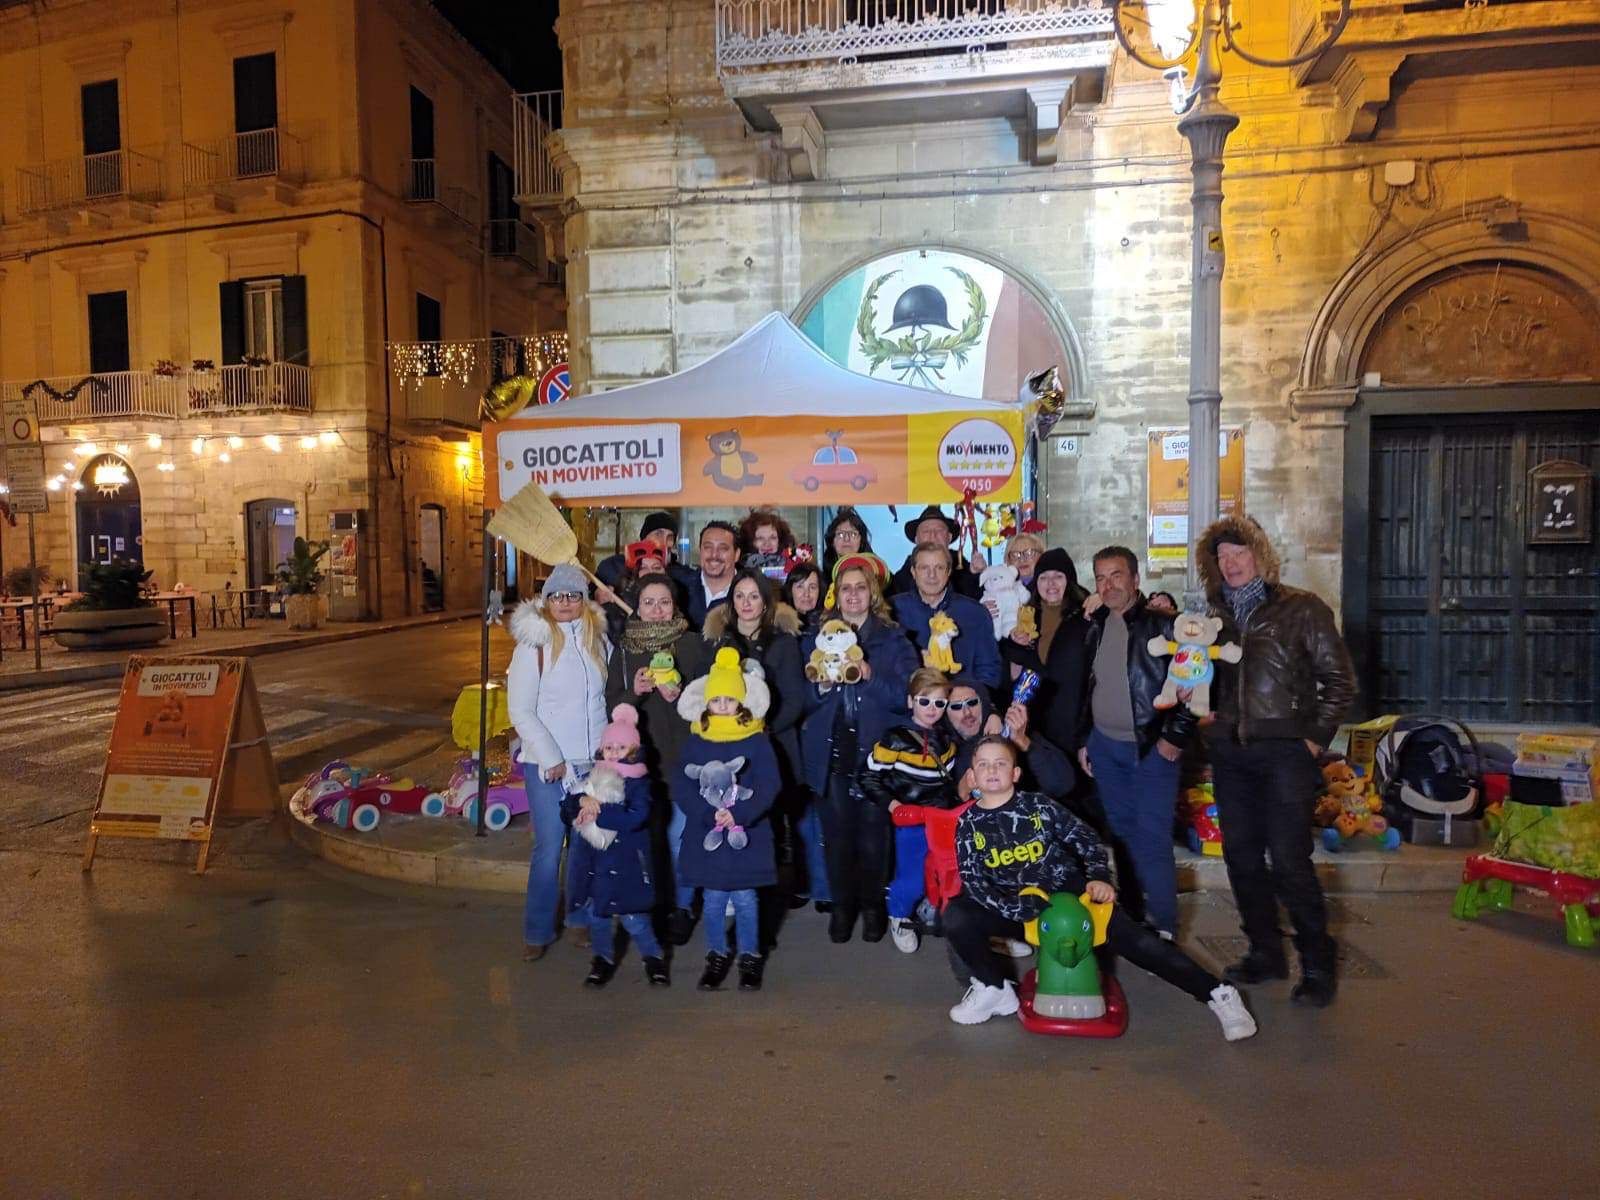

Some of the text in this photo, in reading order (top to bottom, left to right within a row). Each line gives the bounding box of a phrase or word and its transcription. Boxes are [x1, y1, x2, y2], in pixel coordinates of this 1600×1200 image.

[946, 440, 1009, 457] MOVIMENTO
[1061, 439, 1074, 451] 46
[523, 438, 664, 468] GIOCATTOLI
[531, 462, 657, 485] IN MOVIMENTO
[962, 479, 992, 492] 2050
[151, 671, 211, 683] GIOCATTOLI
[153, 681, 207, 691] IN MOVIMENTO
[984, 840, 1044, 868] Jeep
